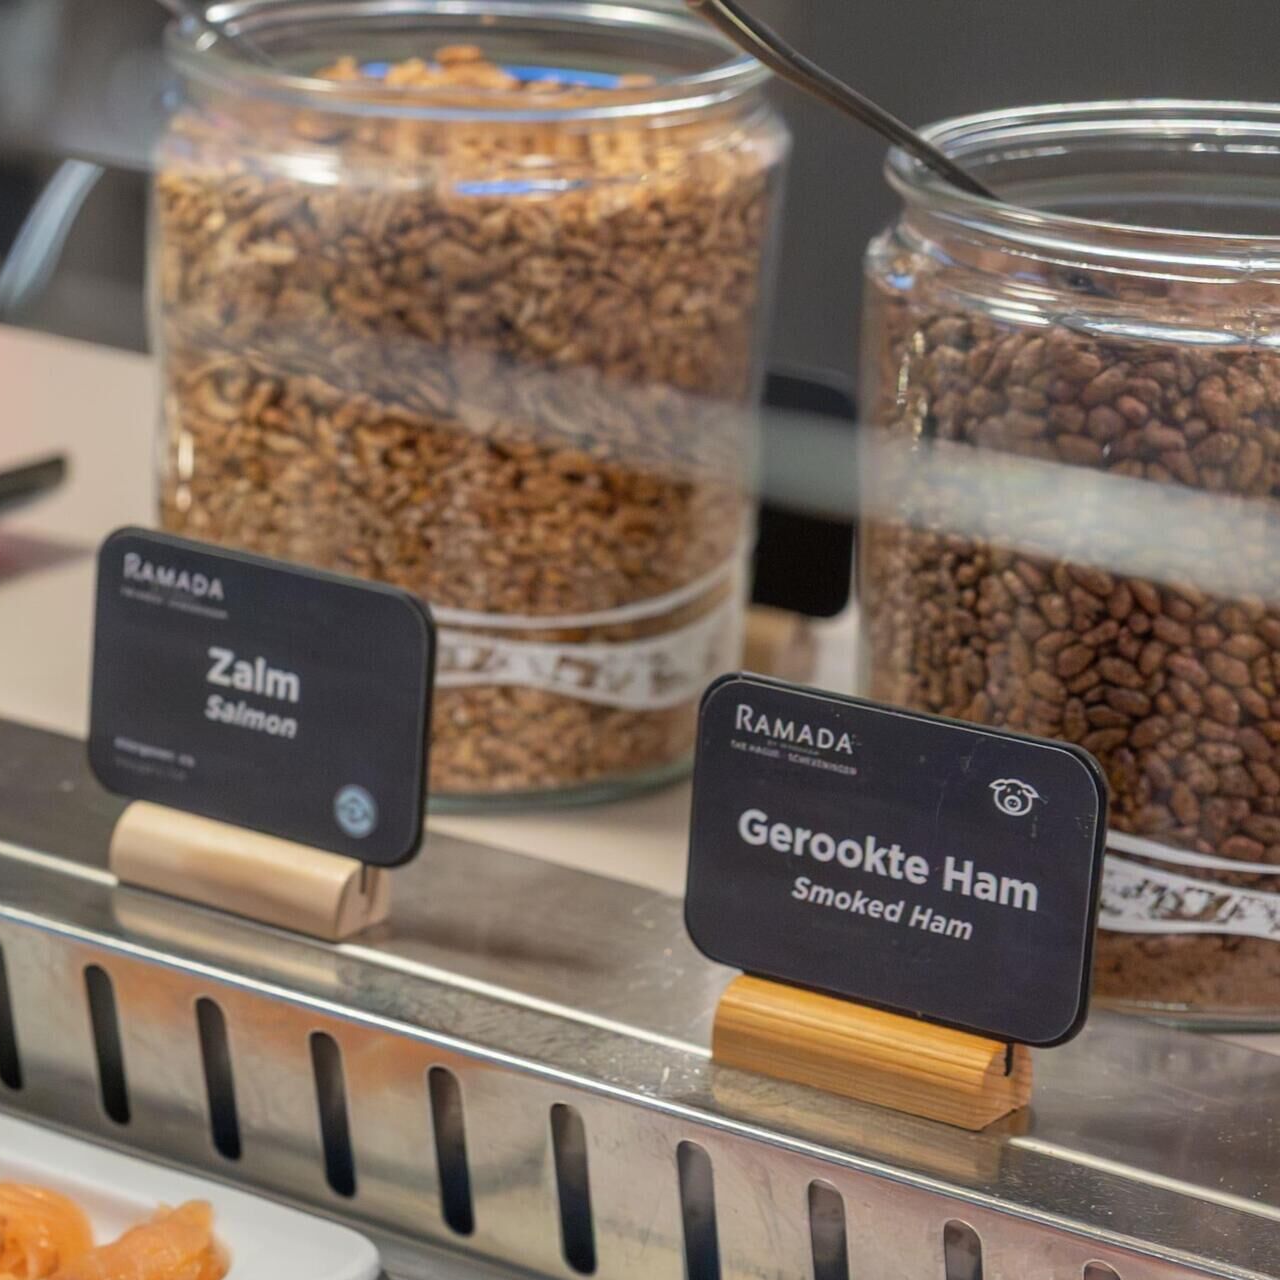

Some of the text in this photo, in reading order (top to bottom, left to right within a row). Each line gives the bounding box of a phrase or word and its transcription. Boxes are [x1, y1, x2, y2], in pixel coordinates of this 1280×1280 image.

[123, 552, 224, 600] RAMADA
[206, 646, 300, 703] Zalm
[204, 694, 298, 739] Salmon
[735, 703, 854, 755] RAMADA
[738, 808, 1038, 912] Gerookte Ham
[791, 876, 973, 941] Smoked Ham
